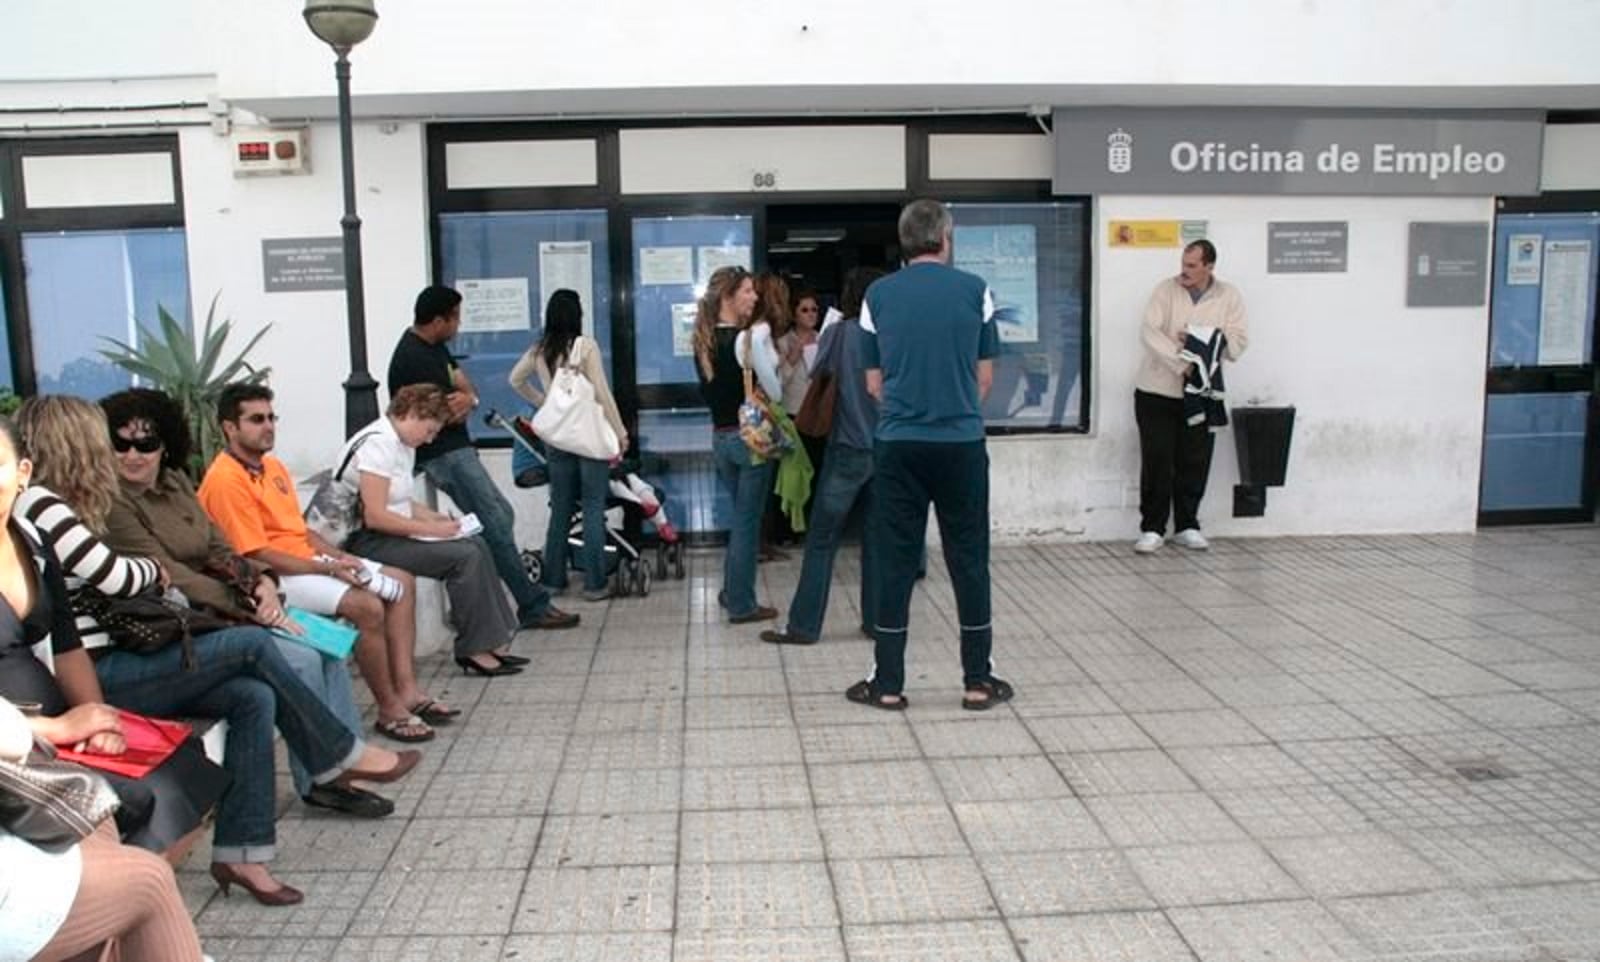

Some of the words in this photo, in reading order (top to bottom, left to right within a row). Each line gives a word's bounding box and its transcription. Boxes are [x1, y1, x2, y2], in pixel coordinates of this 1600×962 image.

[1170, 141, 1304, 172] Oficina
[1316, 144, 1361, 174] de
[1373, 144, 1506, 180] Empleo
